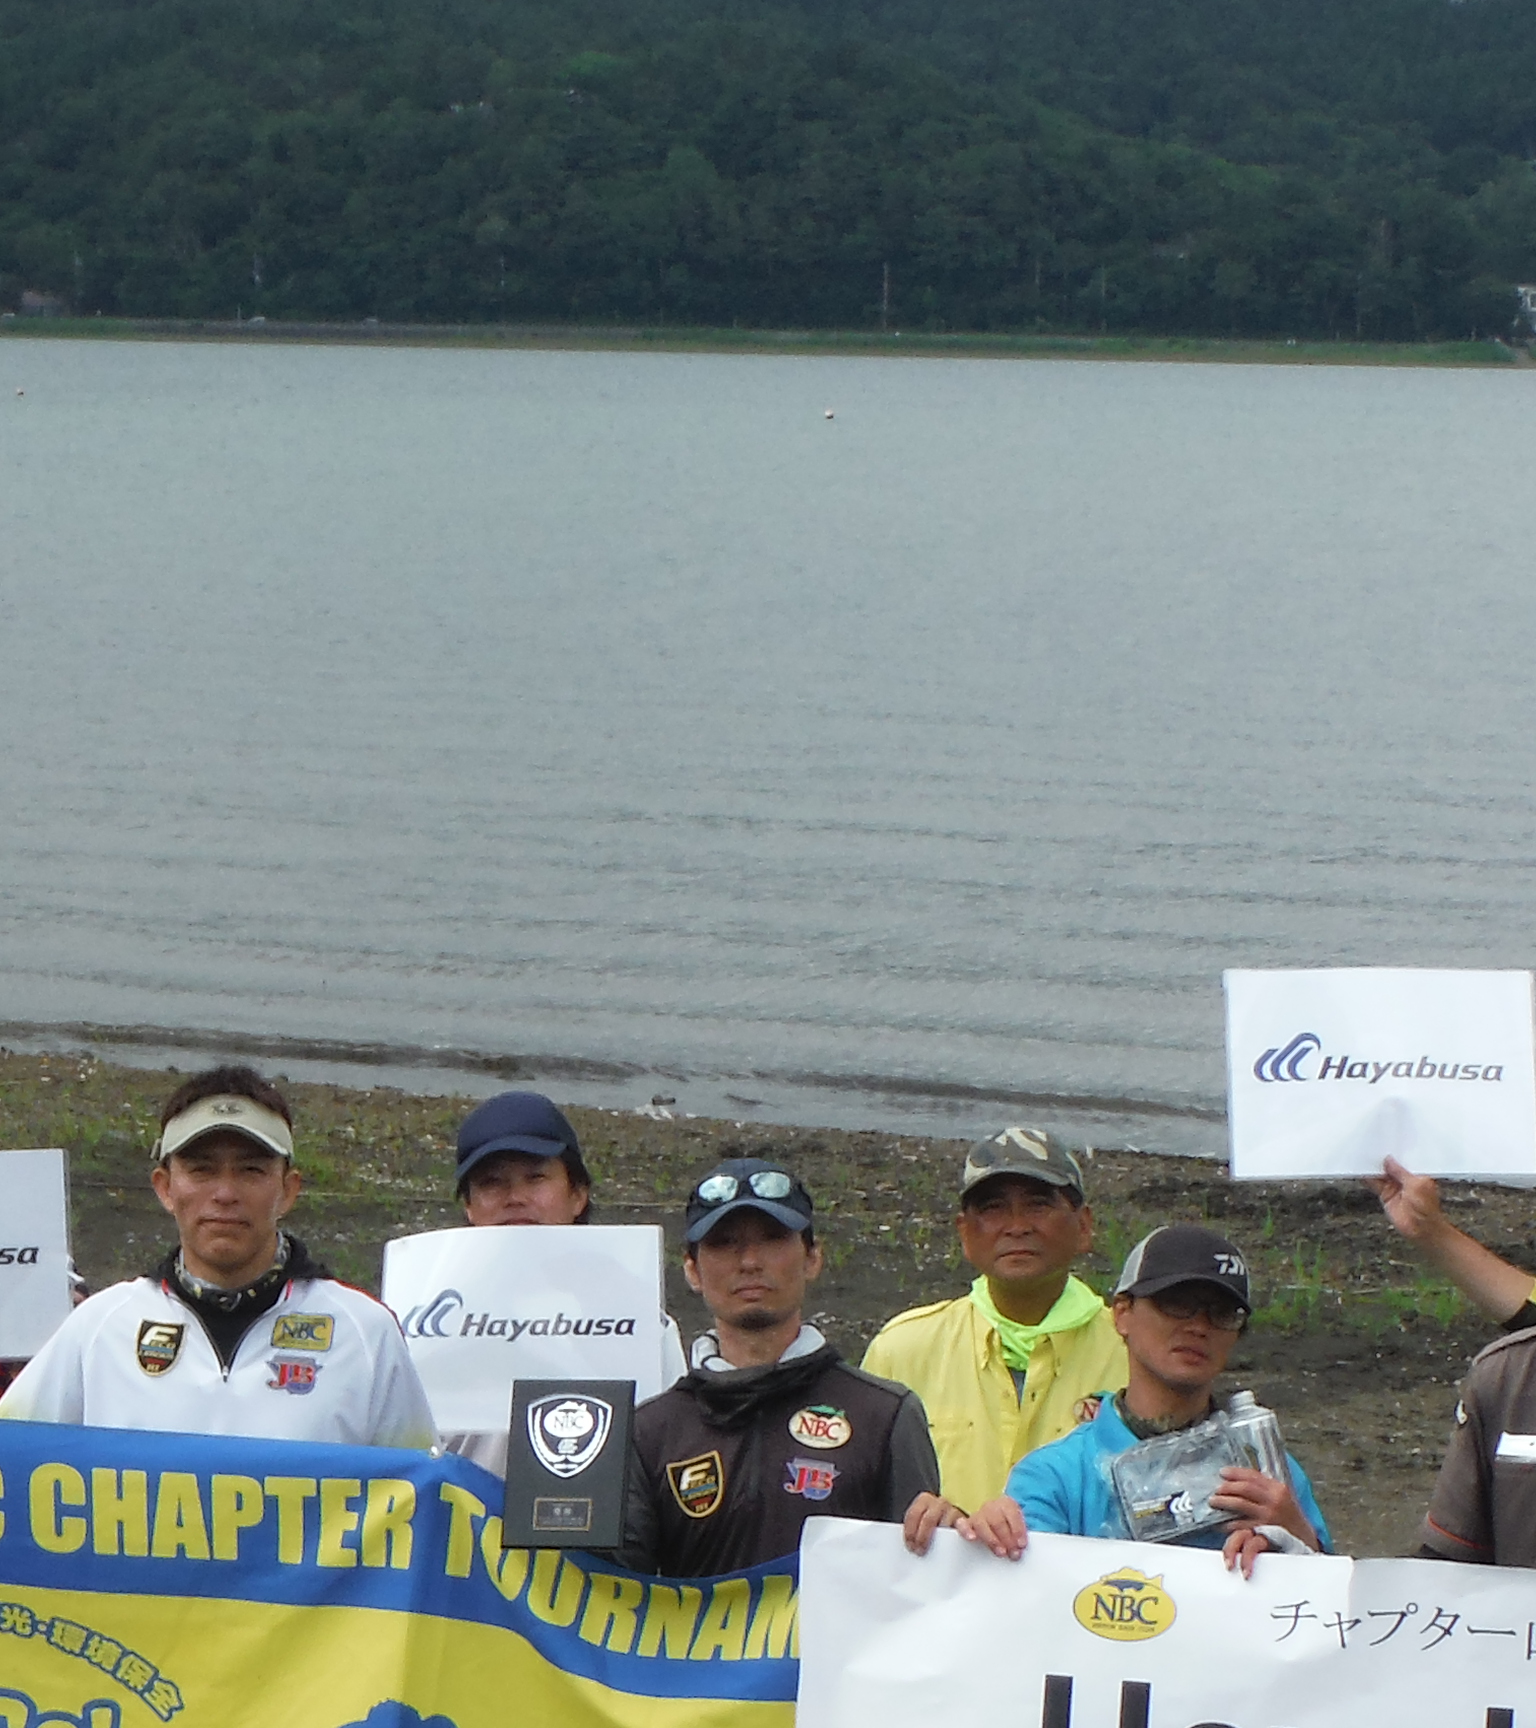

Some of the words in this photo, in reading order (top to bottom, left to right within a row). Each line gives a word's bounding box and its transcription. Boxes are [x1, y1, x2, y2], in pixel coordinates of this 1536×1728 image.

[1318, 1056, 1504, 1085] Hayabusa
[459, 1313, 636, 1342] Hayabusa
[268, 1363, 314, 1389] JB
[797, 1416, 842, 1441] NBC
[785, 1466, 834, 1493] JB
[30, 1461, 417, 1570] CHAPTER
[440, 1482, 800, 1661] TOURNAM
[1090, 1592, 1159, 1625] NBC
